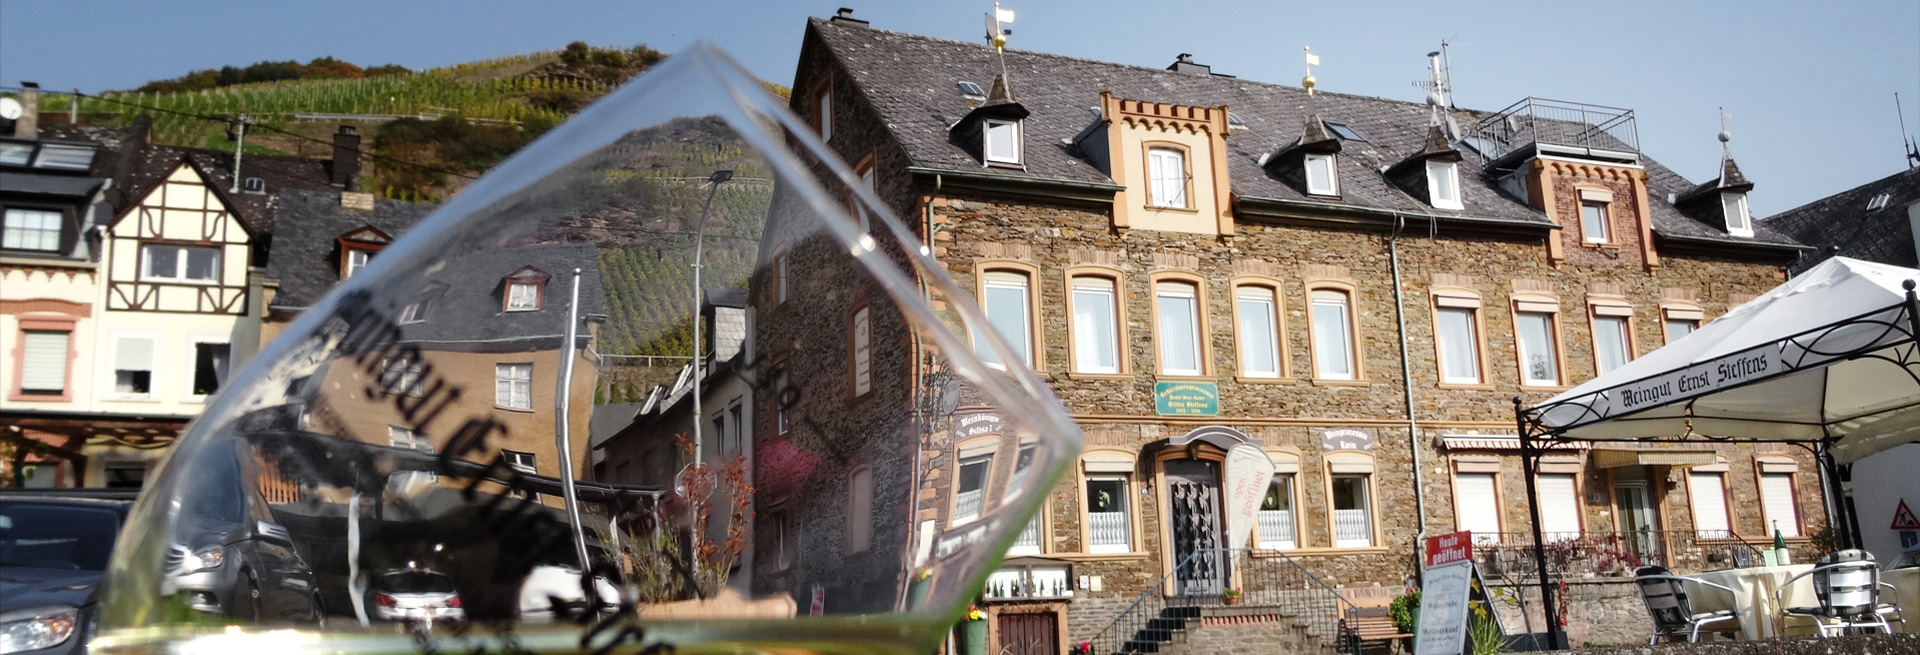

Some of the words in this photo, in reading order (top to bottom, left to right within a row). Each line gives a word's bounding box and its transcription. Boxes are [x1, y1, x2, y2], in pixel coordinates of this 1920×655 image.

[1621, 381, 1671, 408] Weingut
[1678, 371, 1710, 393] Ernst
[1717, 353, 1768, 385] Steffens
[968, 425, 989, 436] Silvia
[1234, 477, 1246, 499] open
[1242, 470, 1265, 518] geöffnet
[1439, 535, 1458, 548] Heute
[1432, 546, 1466, 565] geöffnet
